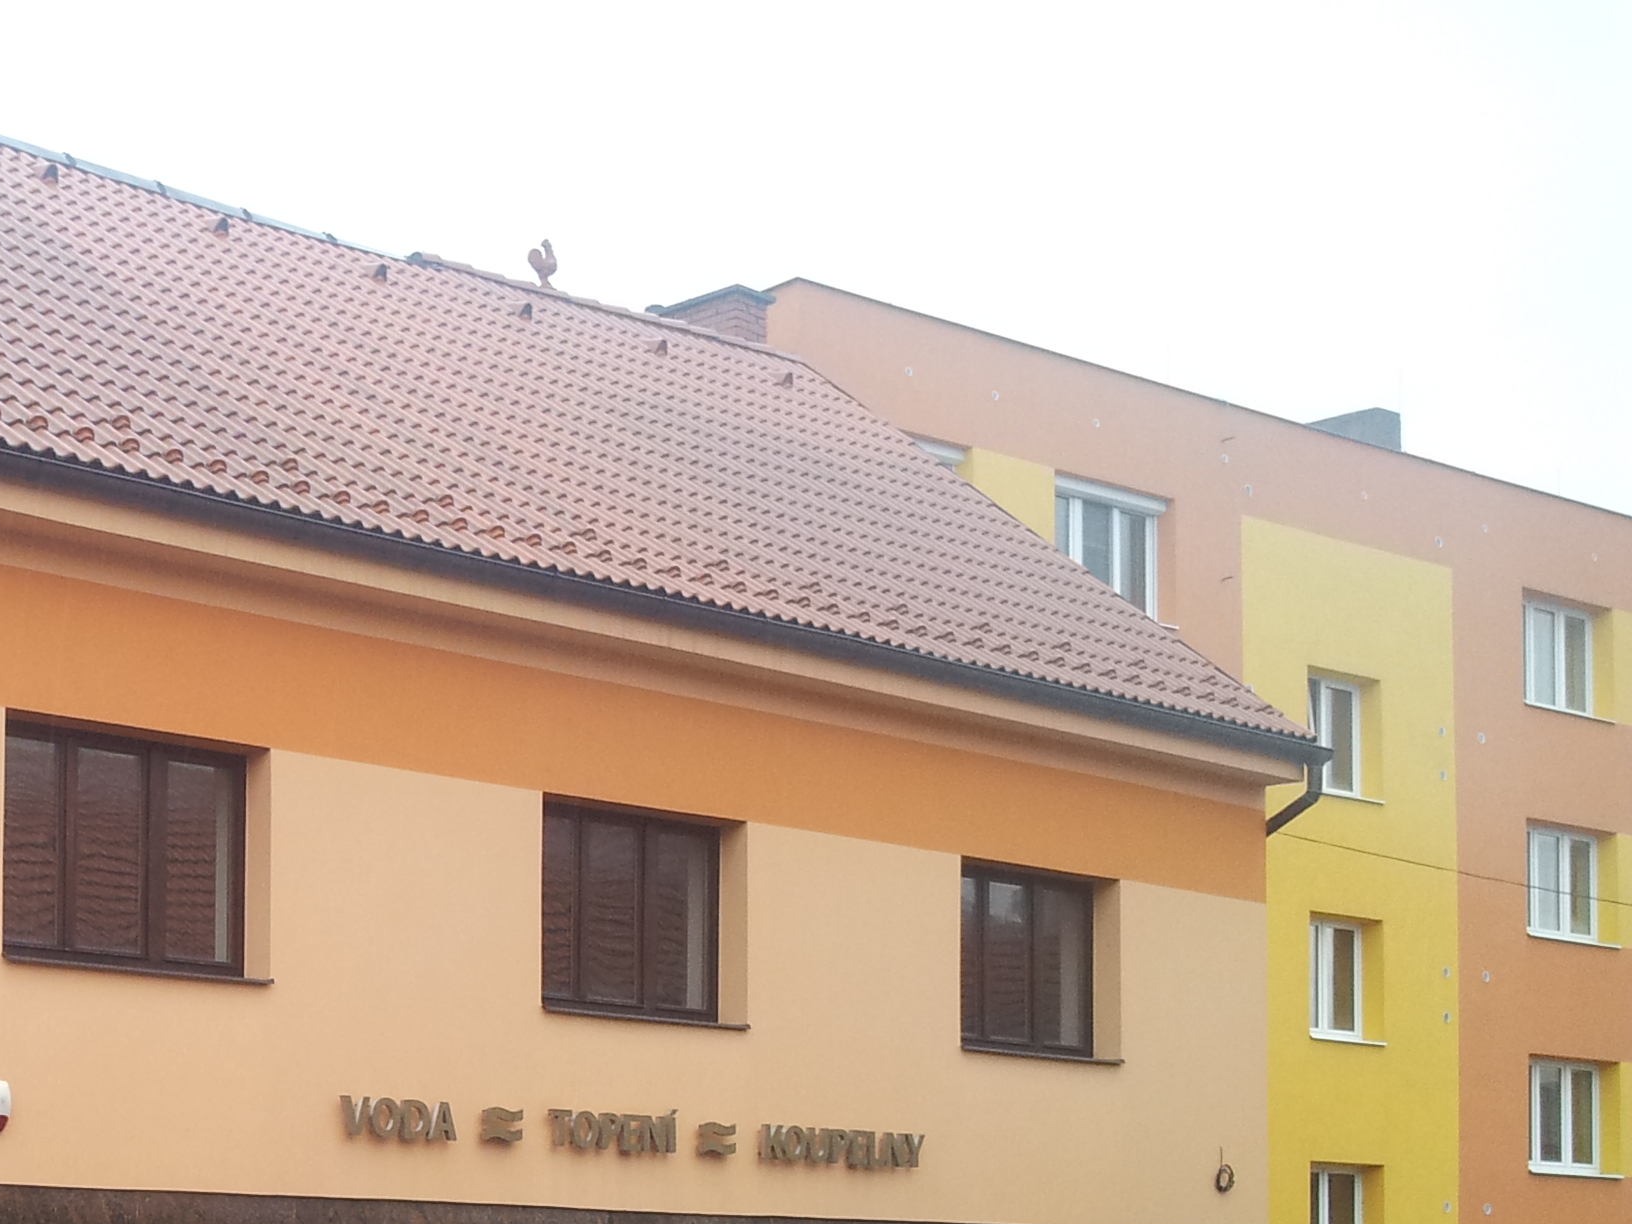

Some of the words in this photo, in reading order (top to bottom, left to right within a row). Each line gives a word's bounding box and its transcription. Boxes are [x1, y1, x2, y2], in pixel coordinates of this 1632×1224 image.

[339, 1095, 457, 1141] VODA
[548, 1108, 678, 1155] TOPENÍ
[758, 1123, 925, 1169] KOUPELNY
